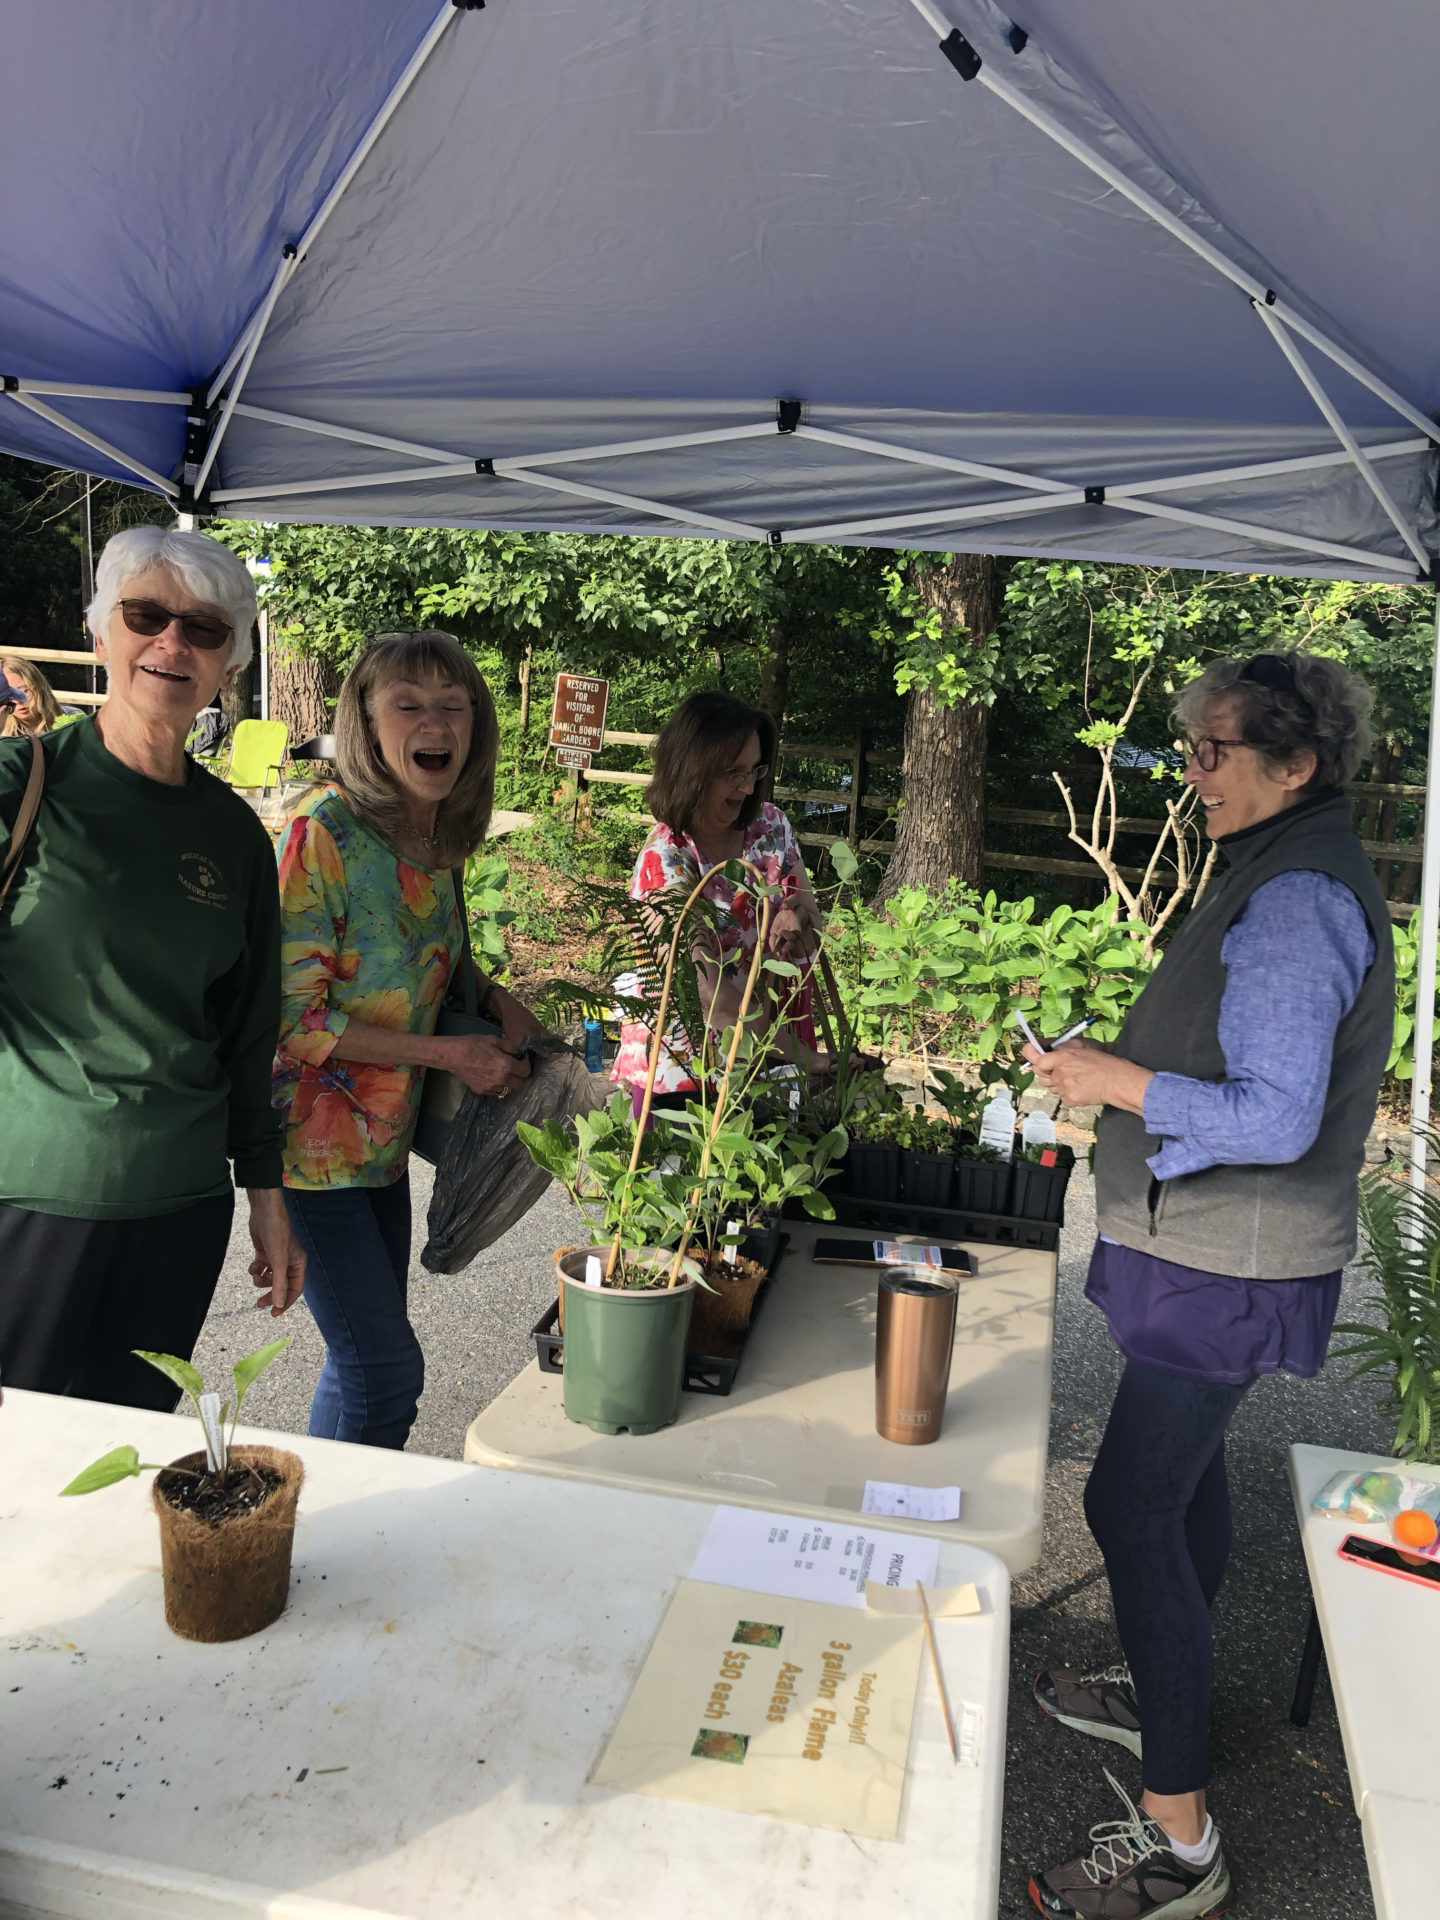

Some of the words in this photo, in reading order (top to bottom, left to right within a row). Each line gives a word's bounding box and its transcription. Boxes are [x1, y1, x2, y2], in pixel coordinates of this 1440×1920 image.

[567, 679, 599, 692] RESERVED
[575, 692, 588, 702] FOR
[566, 701, 595, 714] VISITORS
[561, 734, 591, 746] GARDENS
[579, 725, 601, 737] BOONE
[178, 873, 206, 897] NATURE
[899, 1412, 927, 1422] YETI
[886, 1553, 904, 1587] PRICING
[829, 1640, 852, 1651] 3
[719, 1650, 751, 1680] $30
[817, 1651, 847, 1700] gallon
[704, 1681, 733, 1720] each
[765, 1661, 803, 1723] Azaleas
[854, 1672, 877, 1704] Today
[801, 1707, 837, 1761] Flame
[848, 1705, 871, 1745] Only!!!
